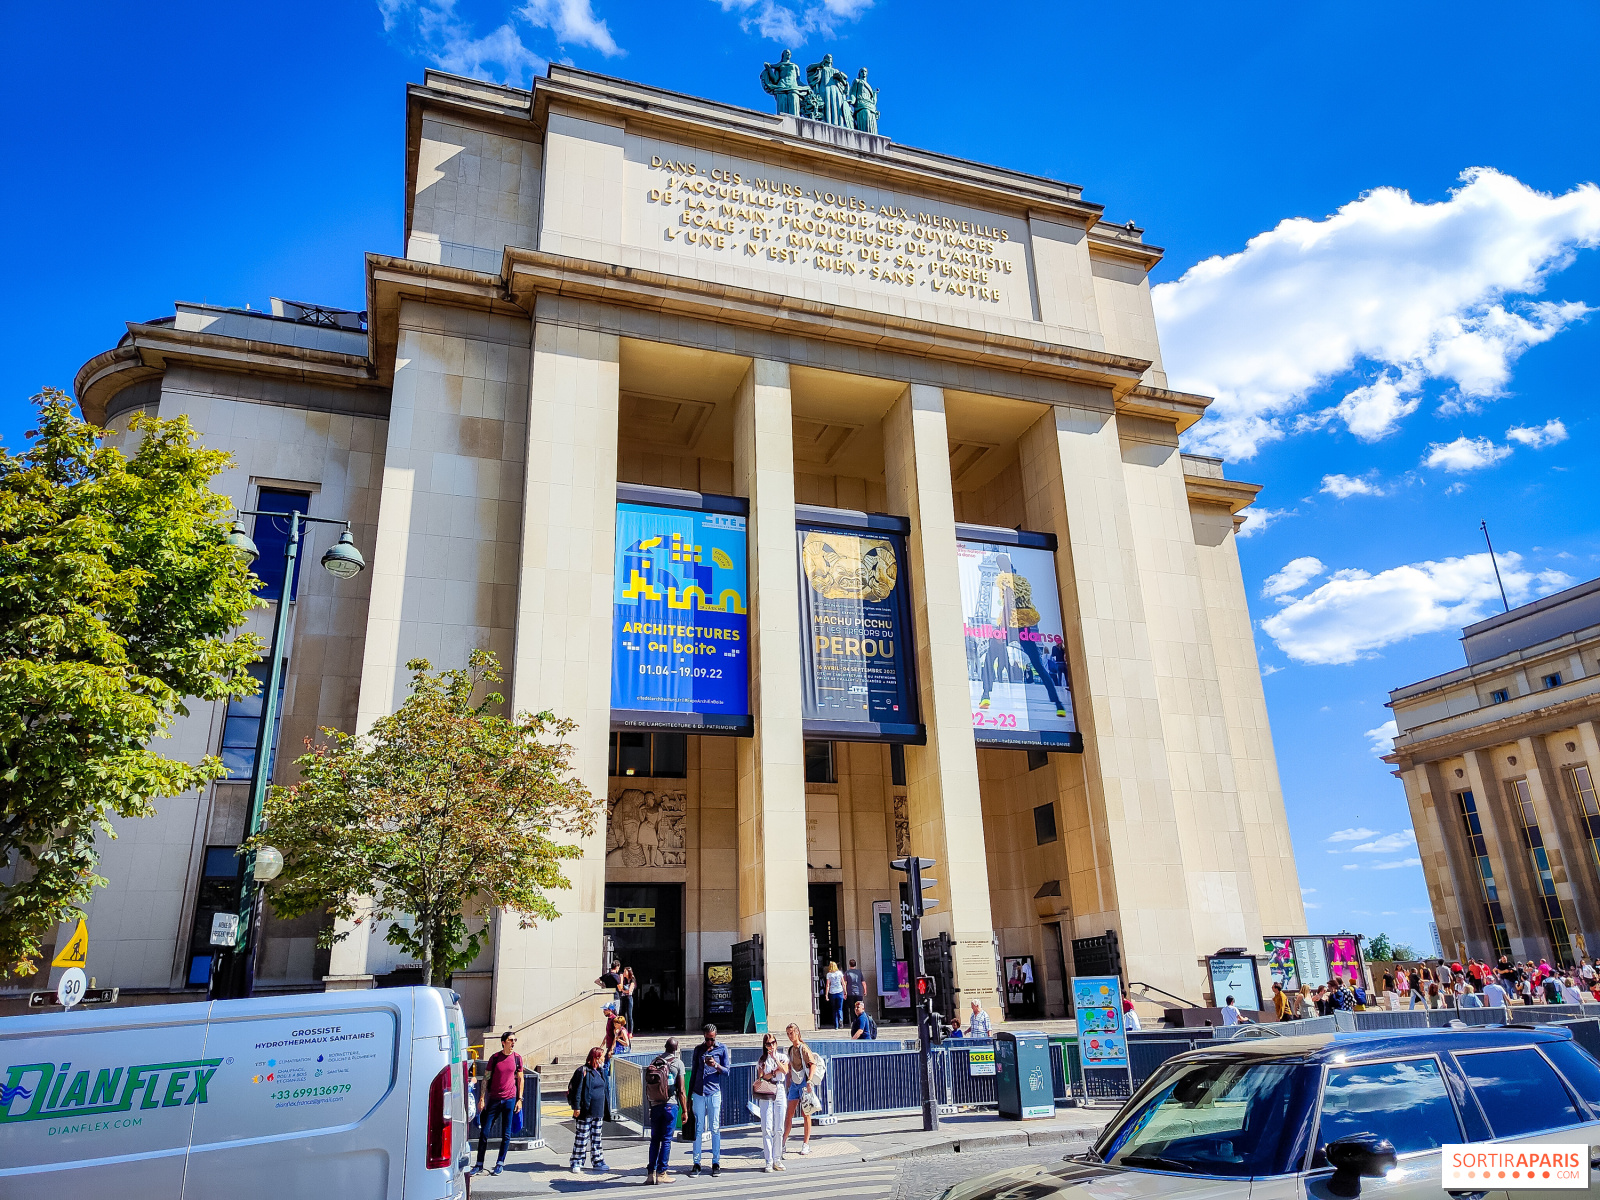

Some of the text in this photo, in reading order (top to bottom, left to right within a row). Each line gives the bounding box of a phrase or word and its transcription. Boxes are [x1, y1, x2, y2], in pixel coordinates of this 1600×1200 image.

[651, 155, 1010, 241] DANS CES MURS VOUÉS AUX MERVEILLES
[669, 176, 996, 253] J'ACCUEILLE ET GARDE LES OUVRAGES
[651, 189, 1013, 273] DE LA MAIN PRODIGIEUSE DE L'ARTISTE
[682, 210, 989, 284] ÉGALE ET RIVALE DE SA PENSÉE
[816, 255, 857, 274] RIEN
[871, 266, 916, 286] SANS
[933, 277, 1001, 302] L'AUTRE
[622, 621, 741, 641] ARCHITECTURES
[814, 615, 893, 629] MACHU PICCHU
[814, 625, 894, 638] ET LES TRÉSORS DU
[963, 622, 1063, 644] haillot danse
[647, 640, 668, 652] en
[815, 634, 895, 658] PÉROU
[850, 666, 883, 674] SEPTEMBRE
[65, 979, 81, 995] 30
[254, 1032, 375, 1050] HYDROTHERMAUX SANITAIRES
[291, 1026, 342, 1037] GROSSISTE
[270, 1083, 352, 1100] +33 699136979
[48, 1117, 143, 1136] DIANFLEX.COM
